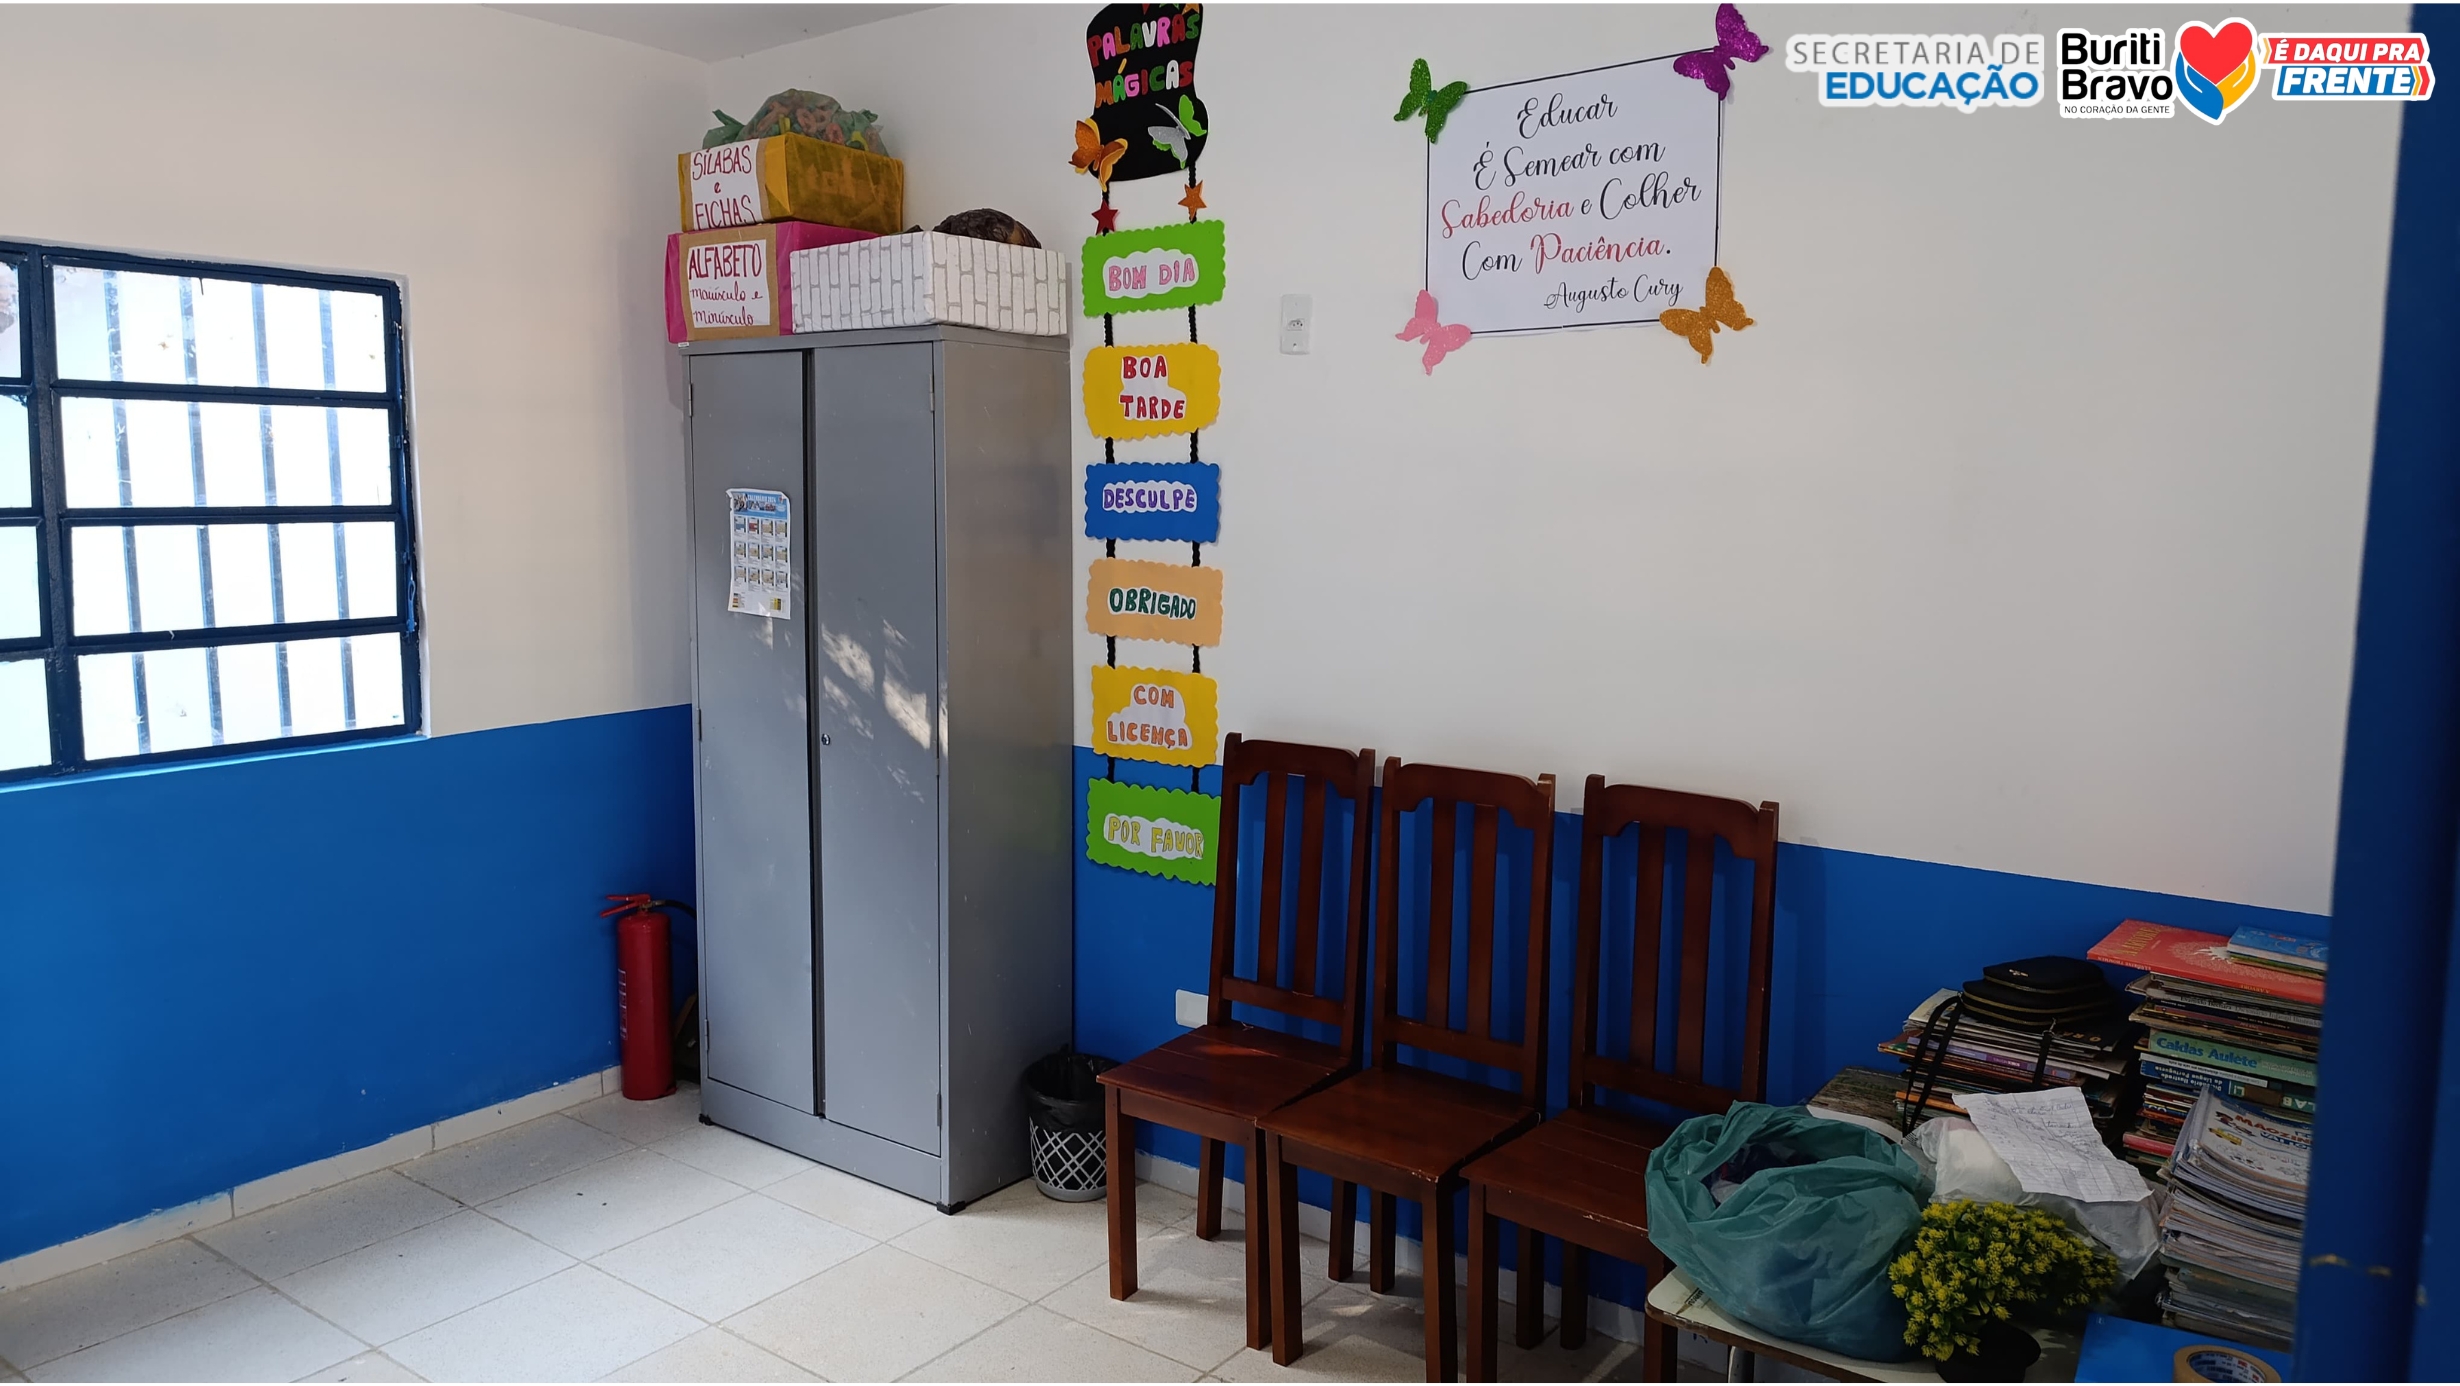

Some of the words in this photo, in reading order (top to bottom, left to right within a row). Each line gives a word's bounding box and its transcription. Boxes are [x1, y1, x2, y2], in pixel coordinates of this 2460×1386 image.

[1087, 13, 1200, 68] PALAVRAS
[1095, 58, 1194, 108] MÁGICAS
[1517, 93, 1618, 139] Educar
[692, 145, 752, 180] SÍLABAS
[1473, 142, 1496, 190] É
[1503, 143, 1601, 187] Semear
[1609, 142, 1665, 165] com
[714, 182, 722, 193] e
[1441, 191, 1574, 239] Sabedoria
[1580, 200, 1593, 216] e
[1600, 171, 1701, 220] Colher
[695, 194, 756, 230] FICHAS
[688, 244, 762, 280] ALFABETO
[1462, 240, 1522, 281] Com
[1530, 232, 1671, 274] Paciência.
[1108, 264, 1147, 292] BOM
[1159, 257, 1196, 286] DIA
[752, 291, 763, 300] e
[1544, 277, 1629, 313] Augusto
[1633, 274, 1683, 306] Cury
[694, 305, 754, 327] minúsculo
[1122, 355, 1168, 379] BOA
[1119, 395, 1185, 420] TARDE
[1104, 488, 1195, 510] DESCULPE
[1109, 587, 1196, 620] OBRIGADO
[1133, 685, 1175, 709] COM
[1107, 720, 1188, 748] LICENÇA
[1108, 816, 1141, 846] POR
[1151, 827, 1204, 859] FAVOR
[2156, 1037, 2204, 1056] Caldas
[2208, 1049, 2258, 1068] Aulete
